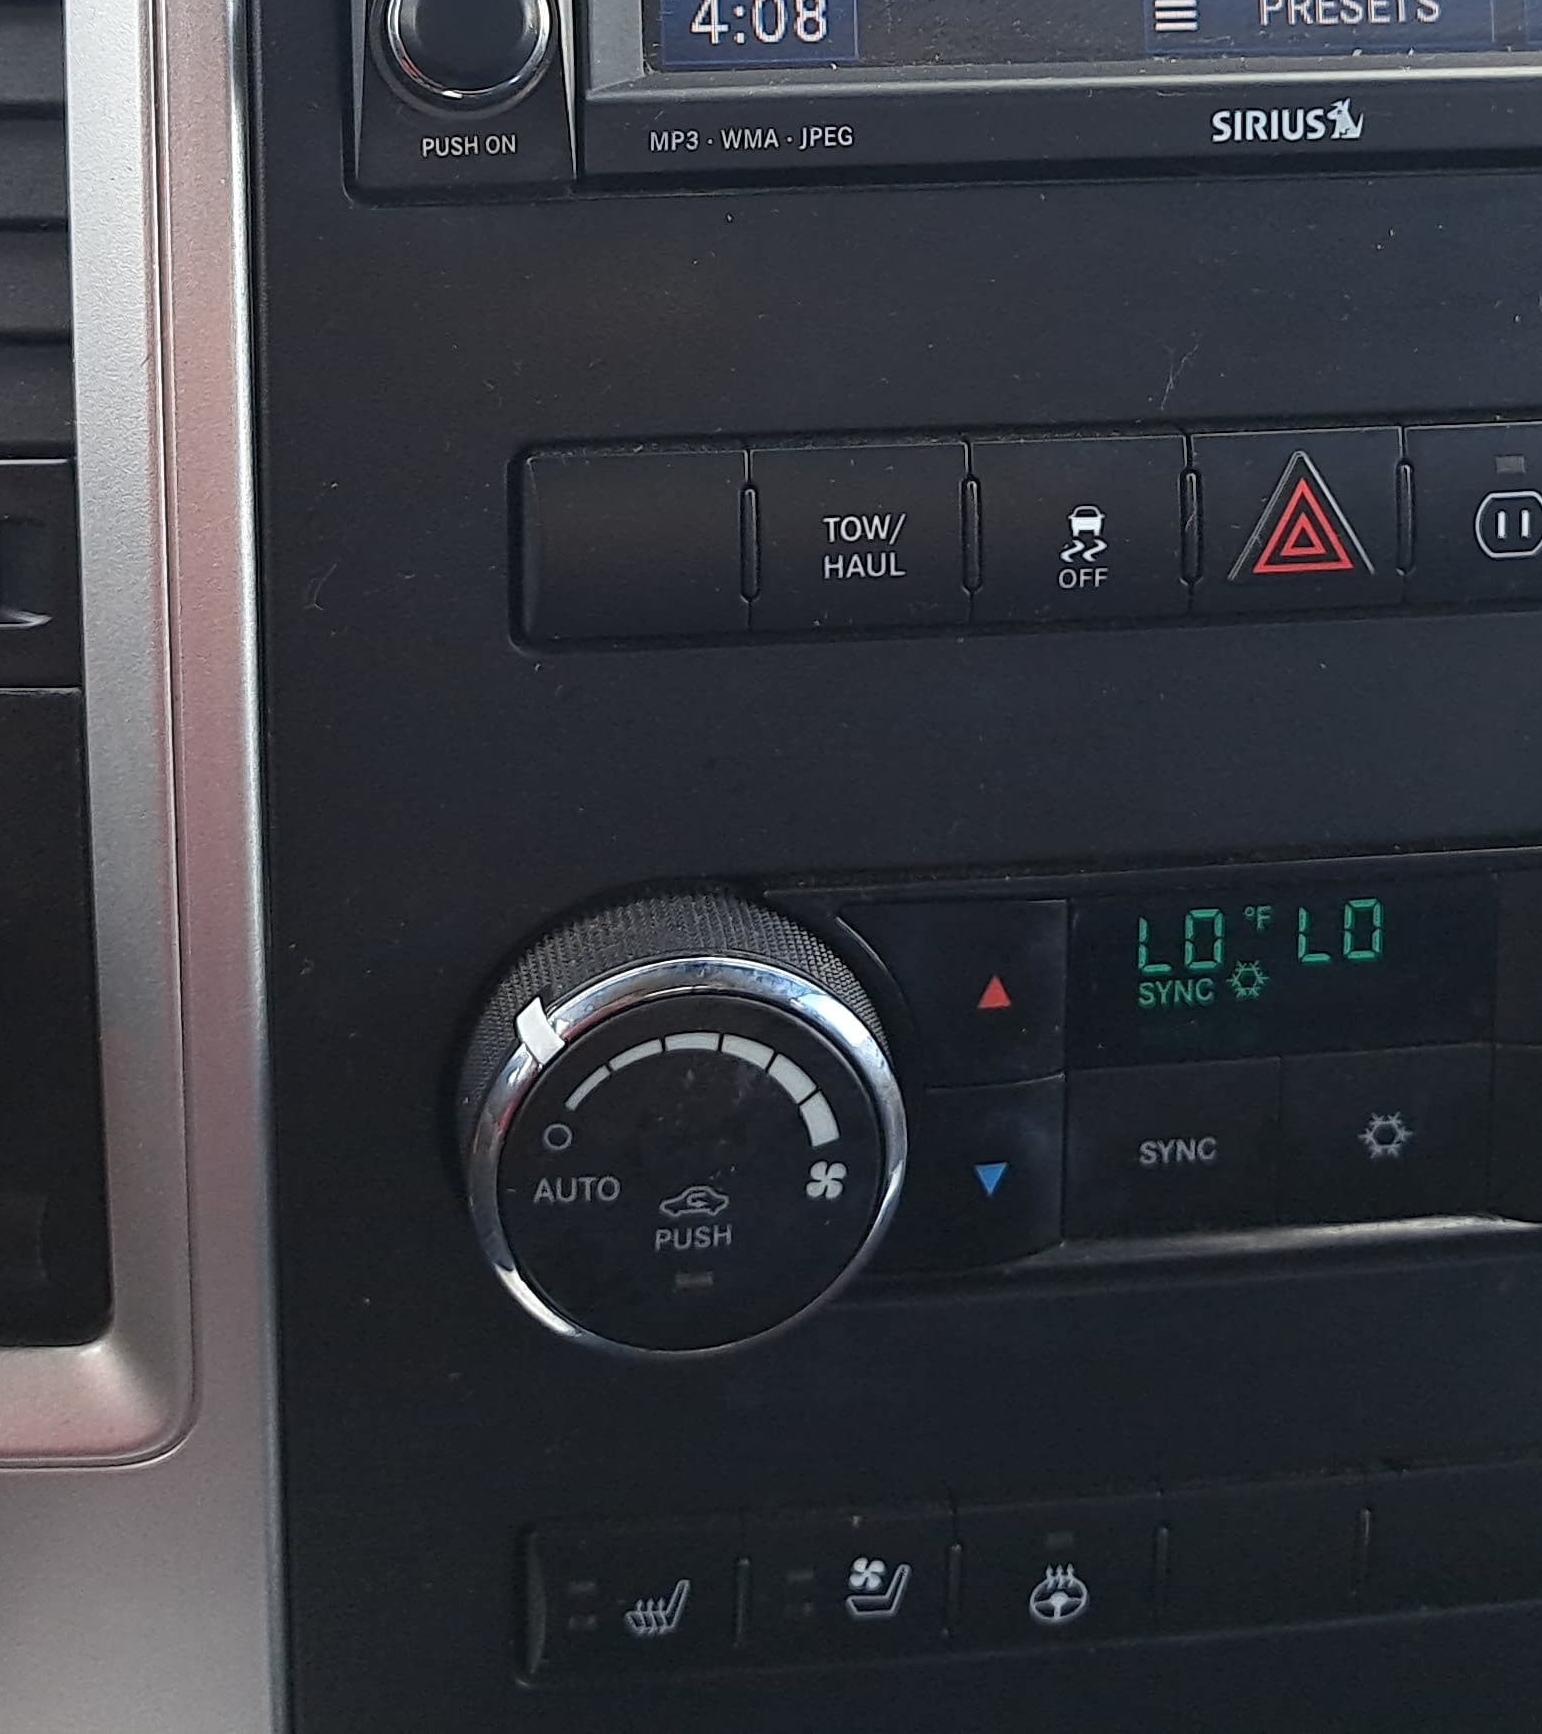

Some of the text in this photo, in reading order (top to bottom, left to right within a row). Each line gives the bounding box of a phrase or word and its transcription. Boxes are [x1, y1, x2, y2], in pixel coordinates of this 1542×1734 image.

[649, 125, 855, 152] MP3 WMA JPEG
[1211, 107, 1326, 143] SIRIUS
[421, 133, 518, 158] PUSH ON
[822, 512, 908, 545] TOW/
[823, 553, 907, 580] HAUL
[1057, 567, 1109, 590] OFF
[1138, 977, 1216, 1008] SYNC
[1138, 1136, 1219, 1166] SYNC
[532, 1175, 621, 1205] AUTO
[654, 1224, 733, 1252] PUSH
